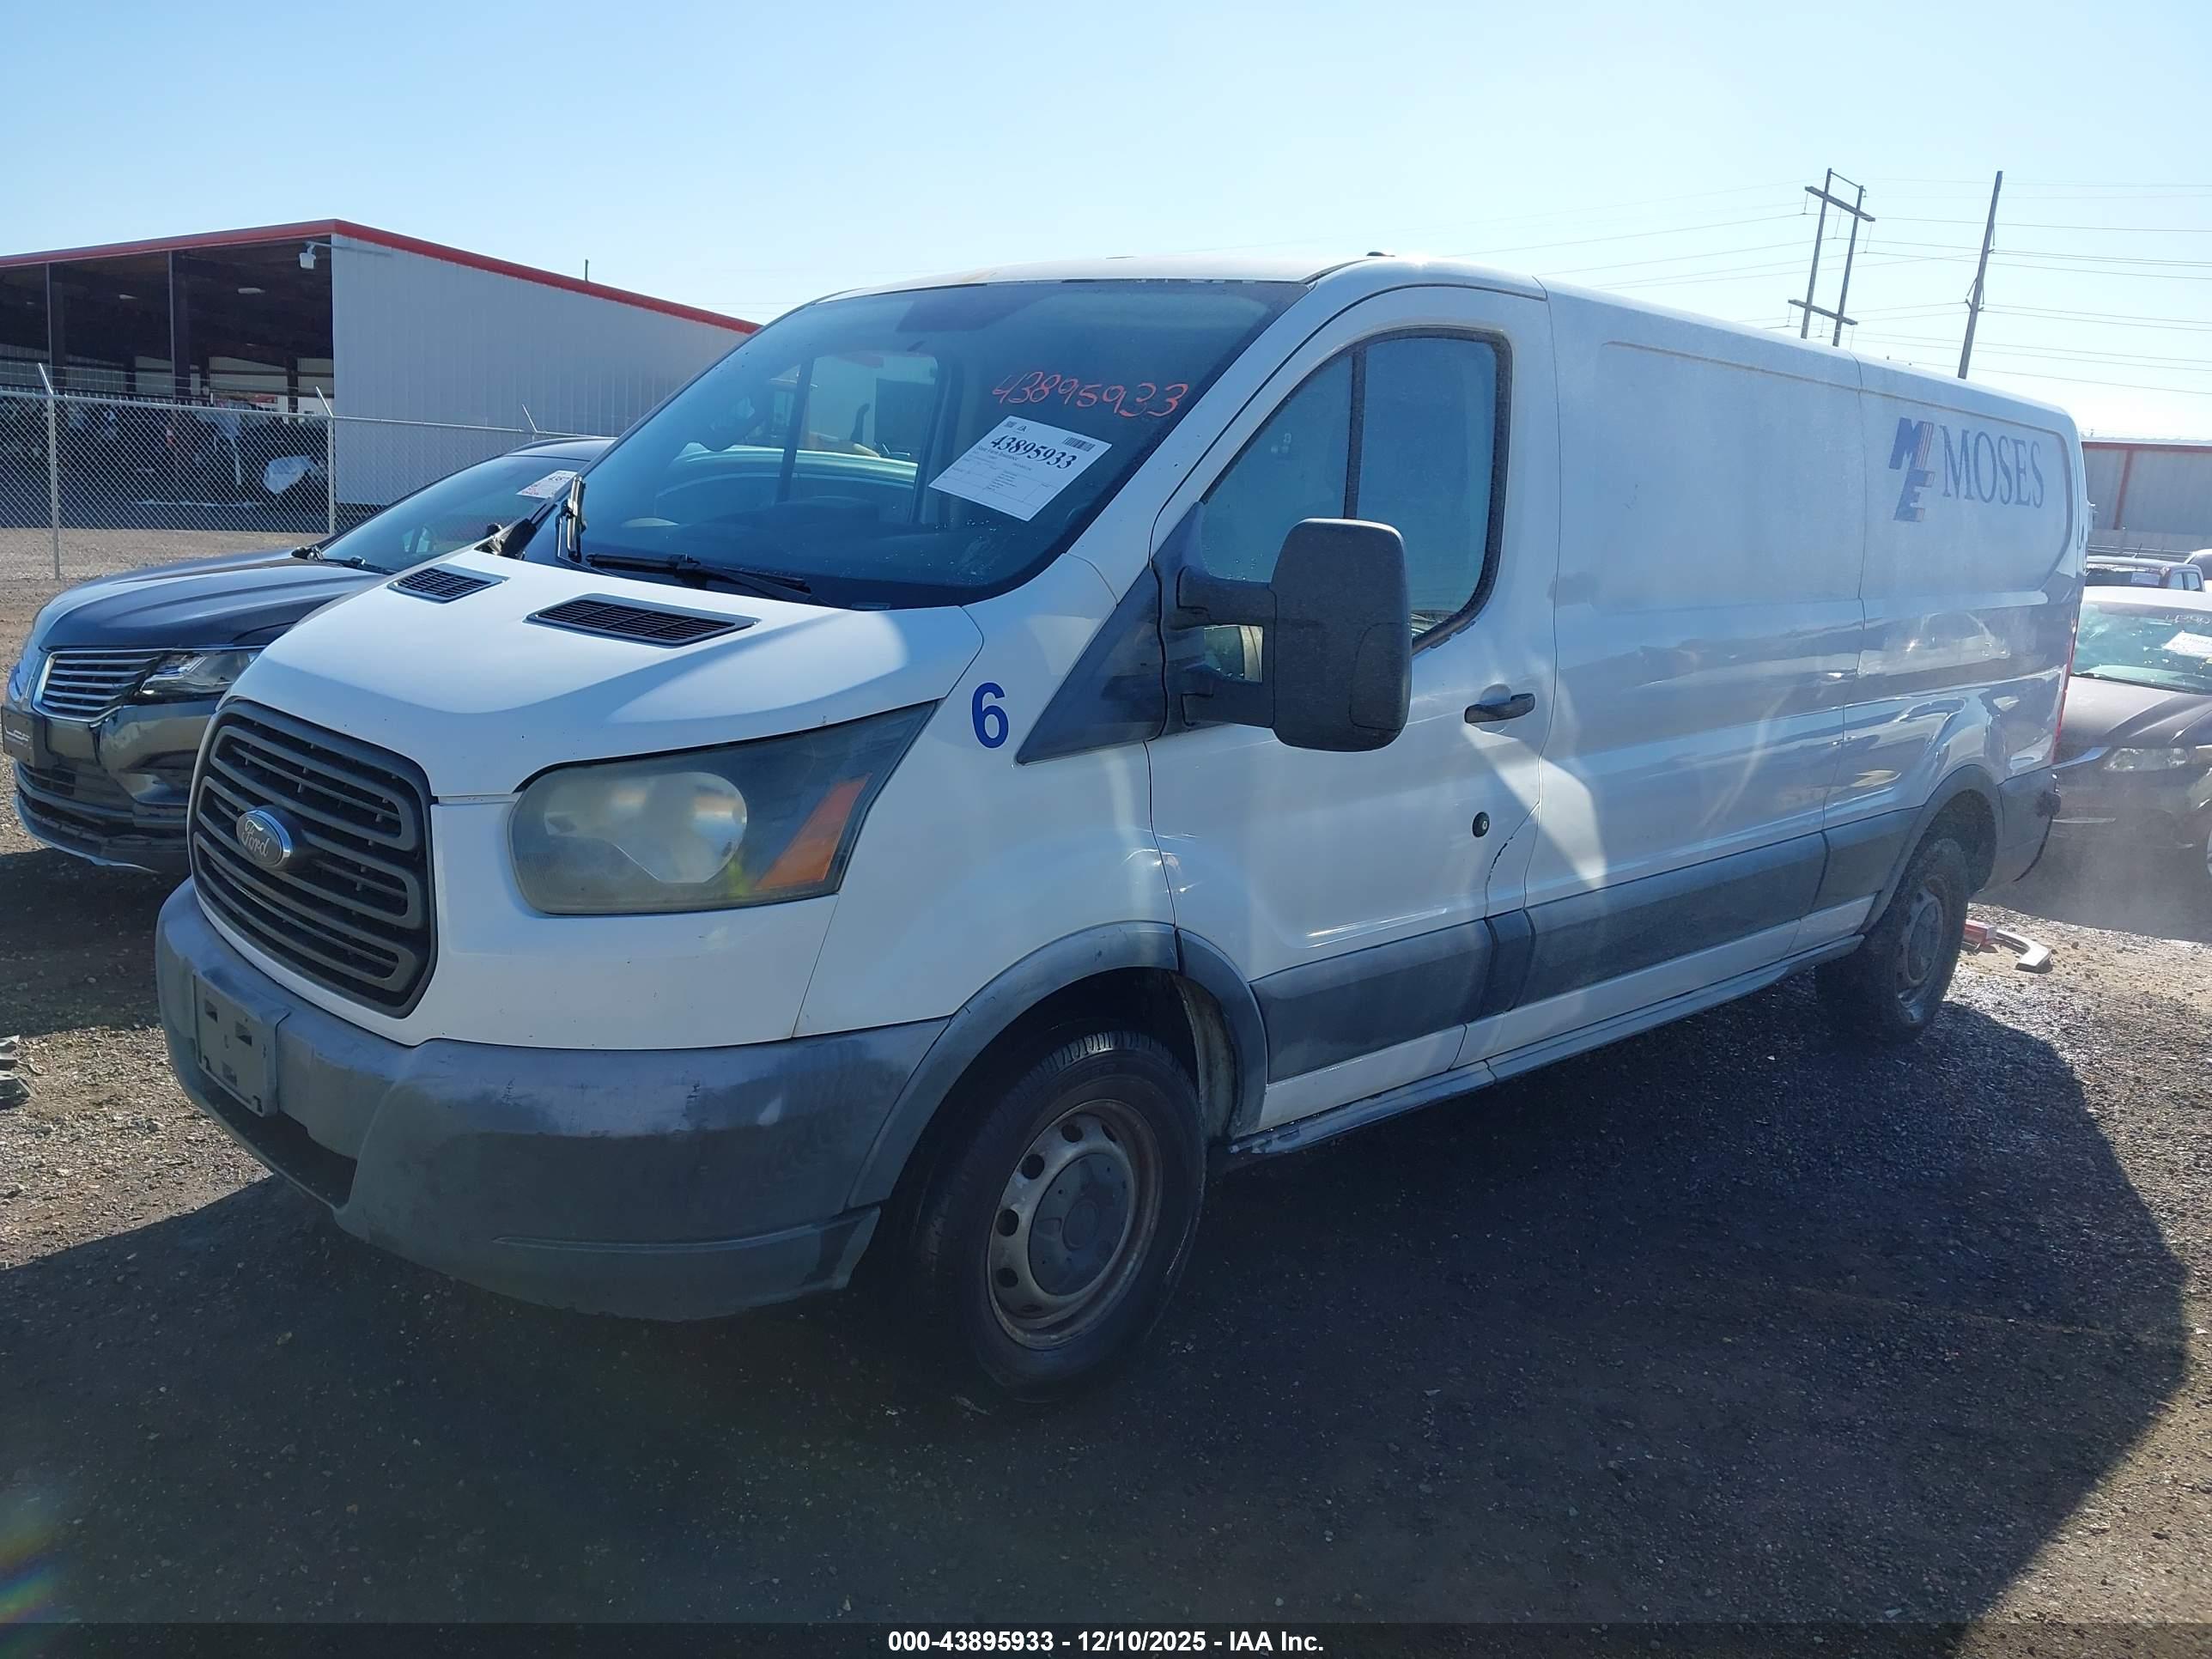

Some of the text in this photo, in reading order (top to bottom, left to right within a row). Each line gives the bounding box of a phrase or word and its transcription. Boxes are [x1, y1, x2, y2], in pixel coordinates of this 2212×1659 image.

[993, 371, 1188, 417] 43895933
[989, 434, 1078, 470] 43895933
[1939, 425, 2044, 508] MOSES
[971, 682, 1009, 749] 6
[241, 818, 270, 858] Ford
